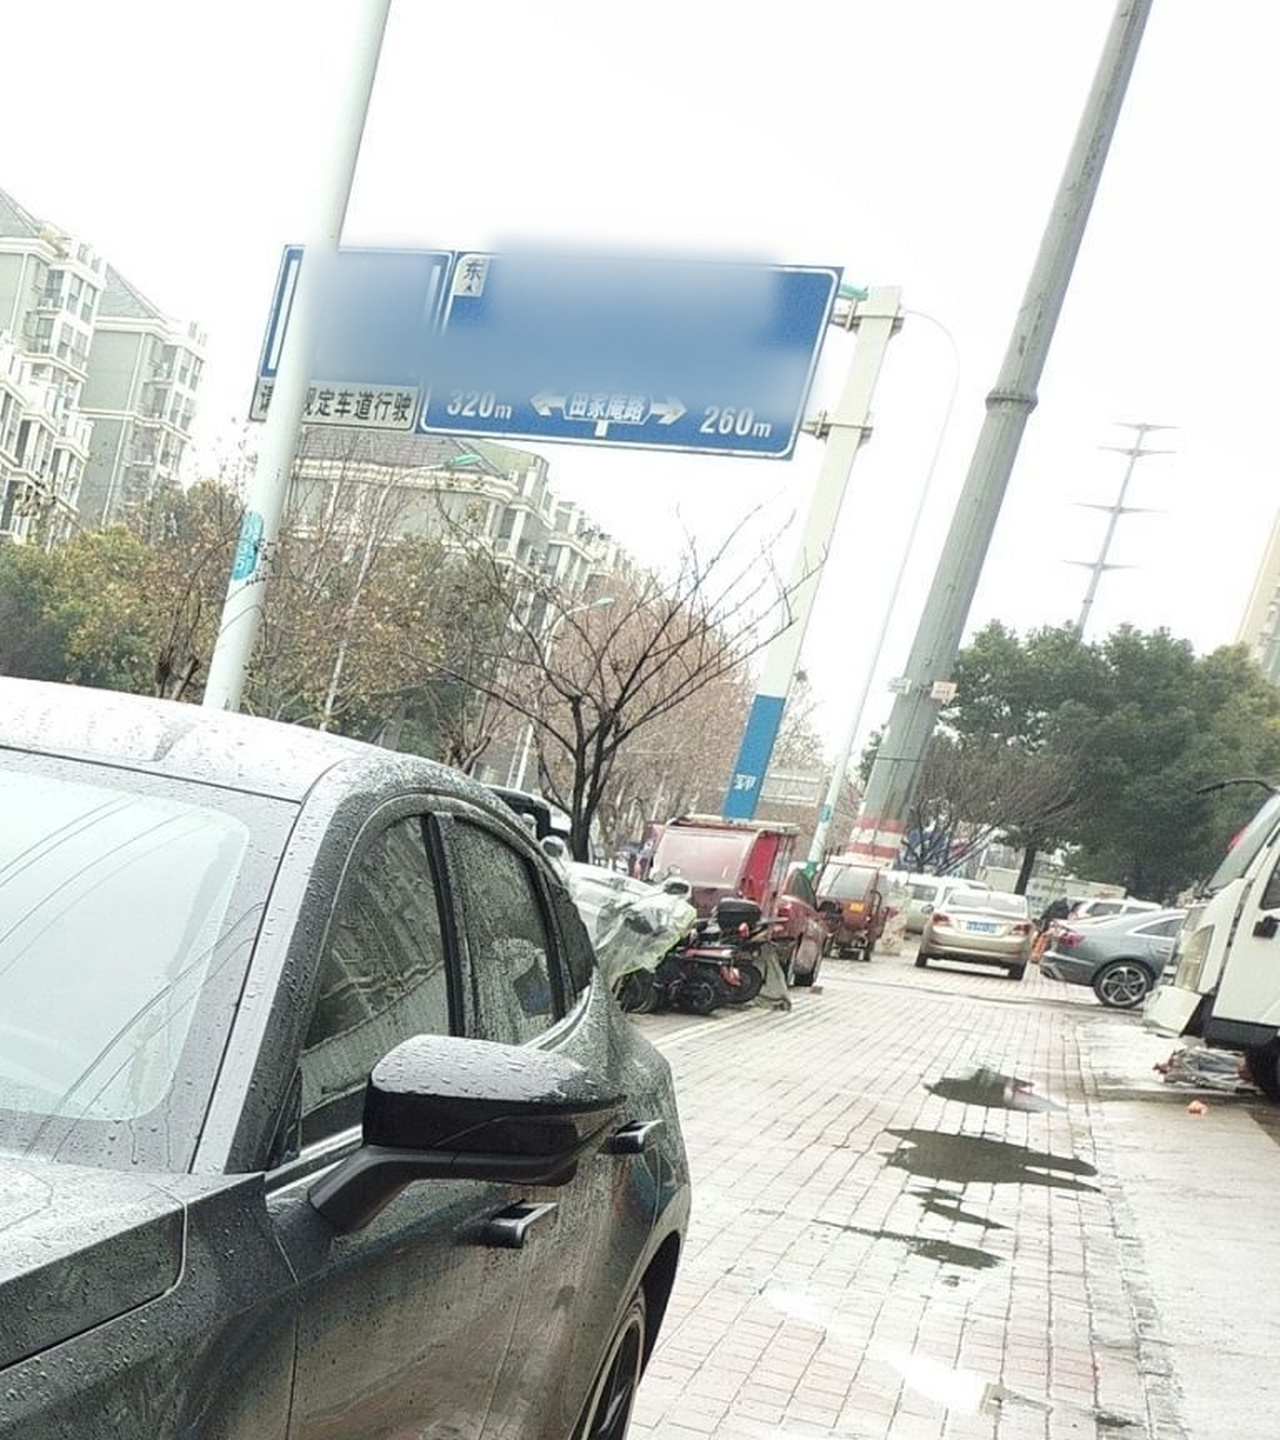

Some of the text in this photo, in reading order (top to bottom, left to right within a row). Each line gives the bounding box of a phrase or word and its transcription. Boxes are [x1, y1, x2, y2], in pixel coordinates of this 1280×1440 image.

[463, 261, 484, 281] 东
[446, 391, 512, 420] 320m
[698, 405, 772, 438] 260m
